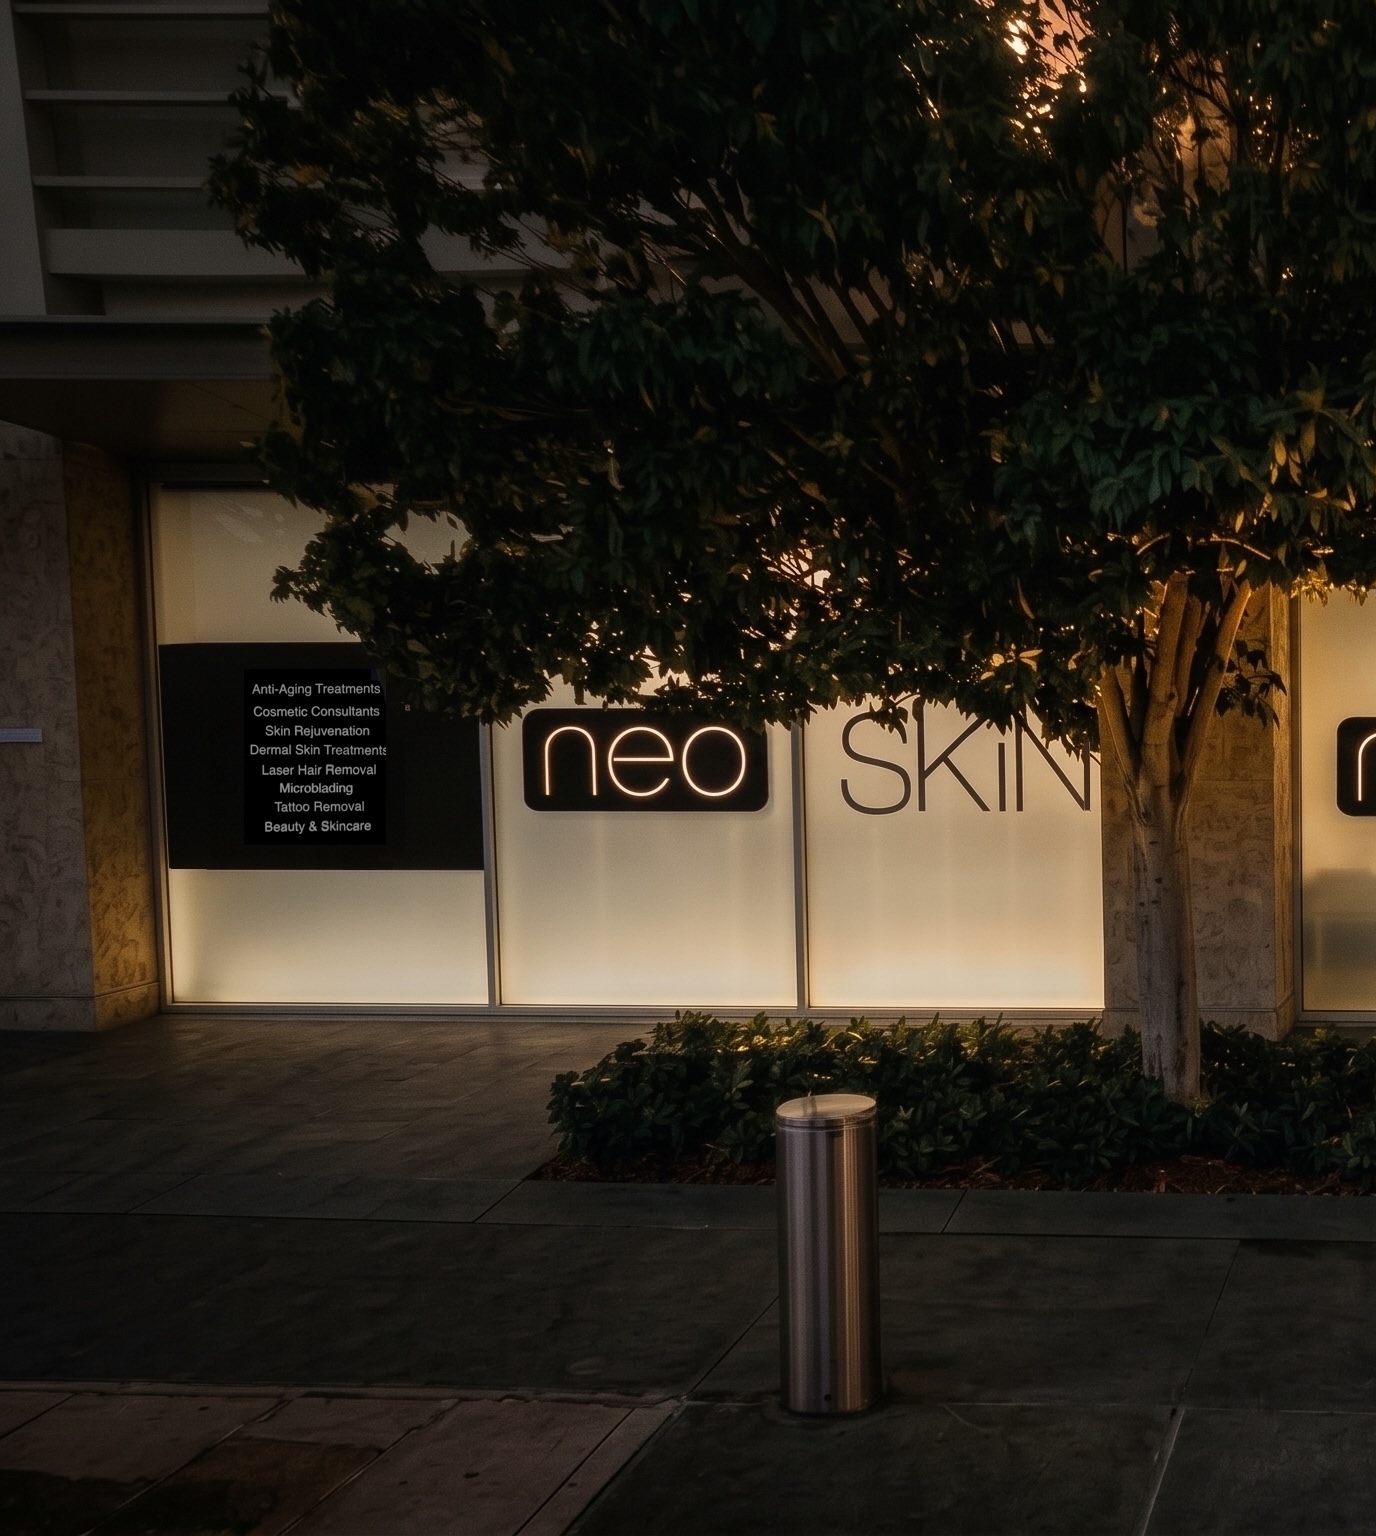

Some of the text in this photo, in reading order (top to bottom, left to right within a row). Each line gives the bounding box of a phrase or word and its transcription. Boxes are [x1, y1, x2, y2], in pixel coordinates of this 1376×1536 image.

[251, 683, 381, 697] Anti-Aging Treatments
[252, 705, 380, 718] Cosmetic Consultants
[265, 724, 370, 739] Skin Rejuvenation
[250, 743, 386, 756] Dermal Skin Treatments
[543, 725, 747, 797] neo
[261, 763, 377, 777] Laser Hair Removal
[279, 782, 354, 796] Microblading
[274, 800, 365, 813] Tattoo Removal
[264, 820, 372, 835] Beauty & Skincare
